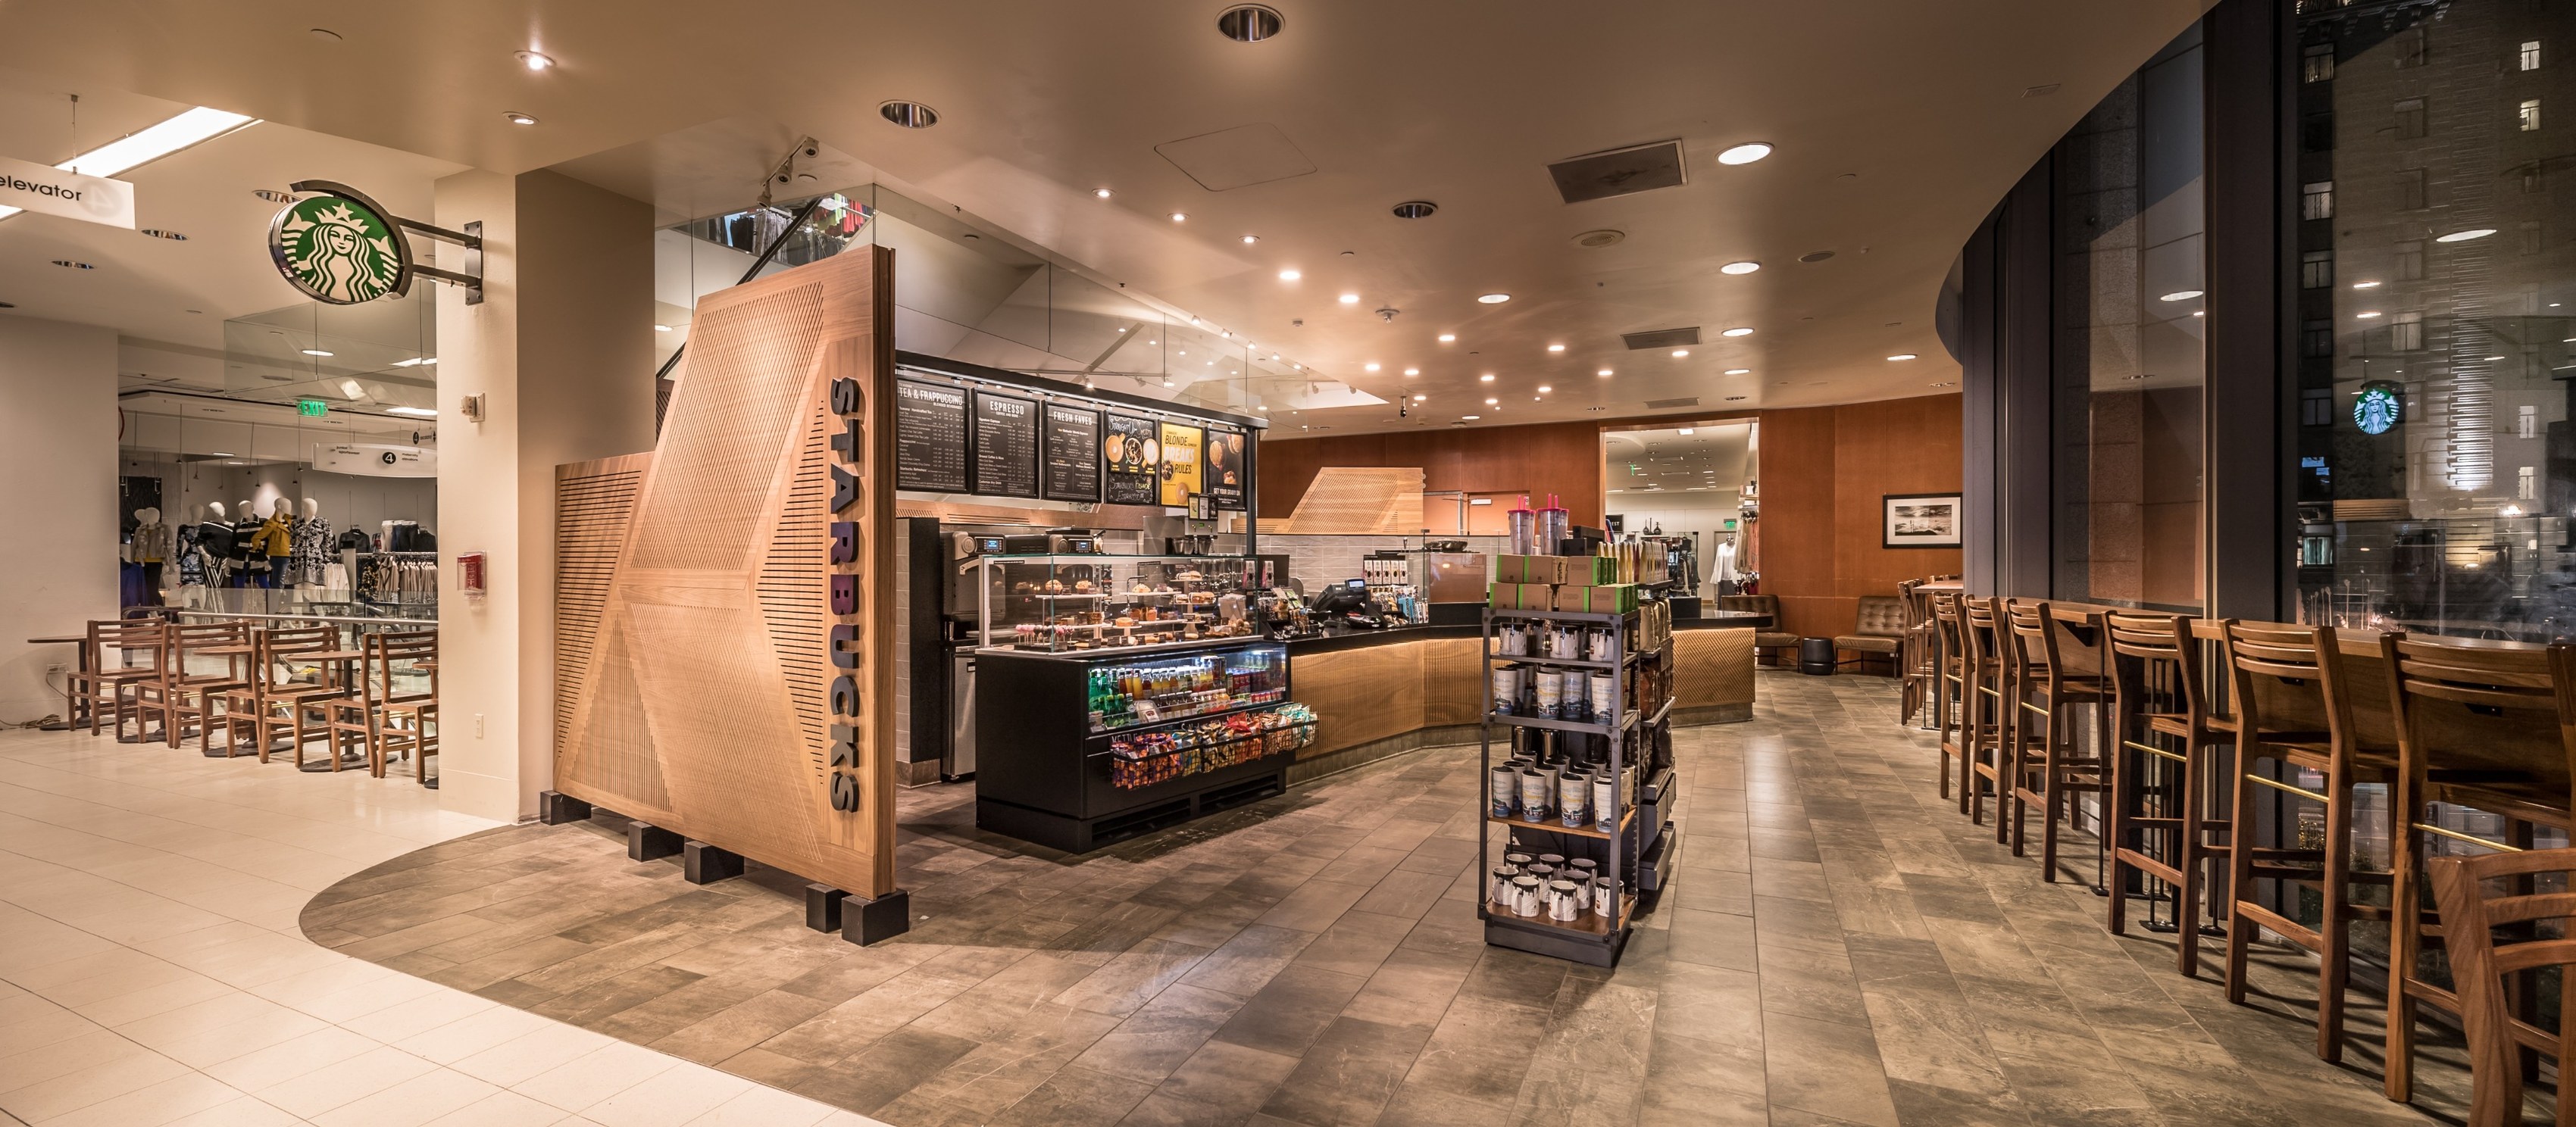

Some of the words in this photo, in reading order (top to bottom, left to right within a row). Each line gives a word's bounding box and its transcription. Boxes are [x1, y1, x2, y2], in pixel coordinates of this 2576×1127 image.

[899, 387, 912, 398] TEA
[913, 389, 919, 399] &
[920, 390, 963, 406] FRAPPUCCINO
[301, 401, 325, 417] EXIT
[989, 401, 1024, 415] ESPRESSO
[1053, 411, 1073, 423] FRESH
[1074, 414, 1093, 426] FAVES
[1165, 435, 1188, 447] BLONDE
[1163, 445, 1195, 464] BREAKS
[1174, 464, 1193, 474] RULES
[830, 376, 860, 814] STARBUCKS
